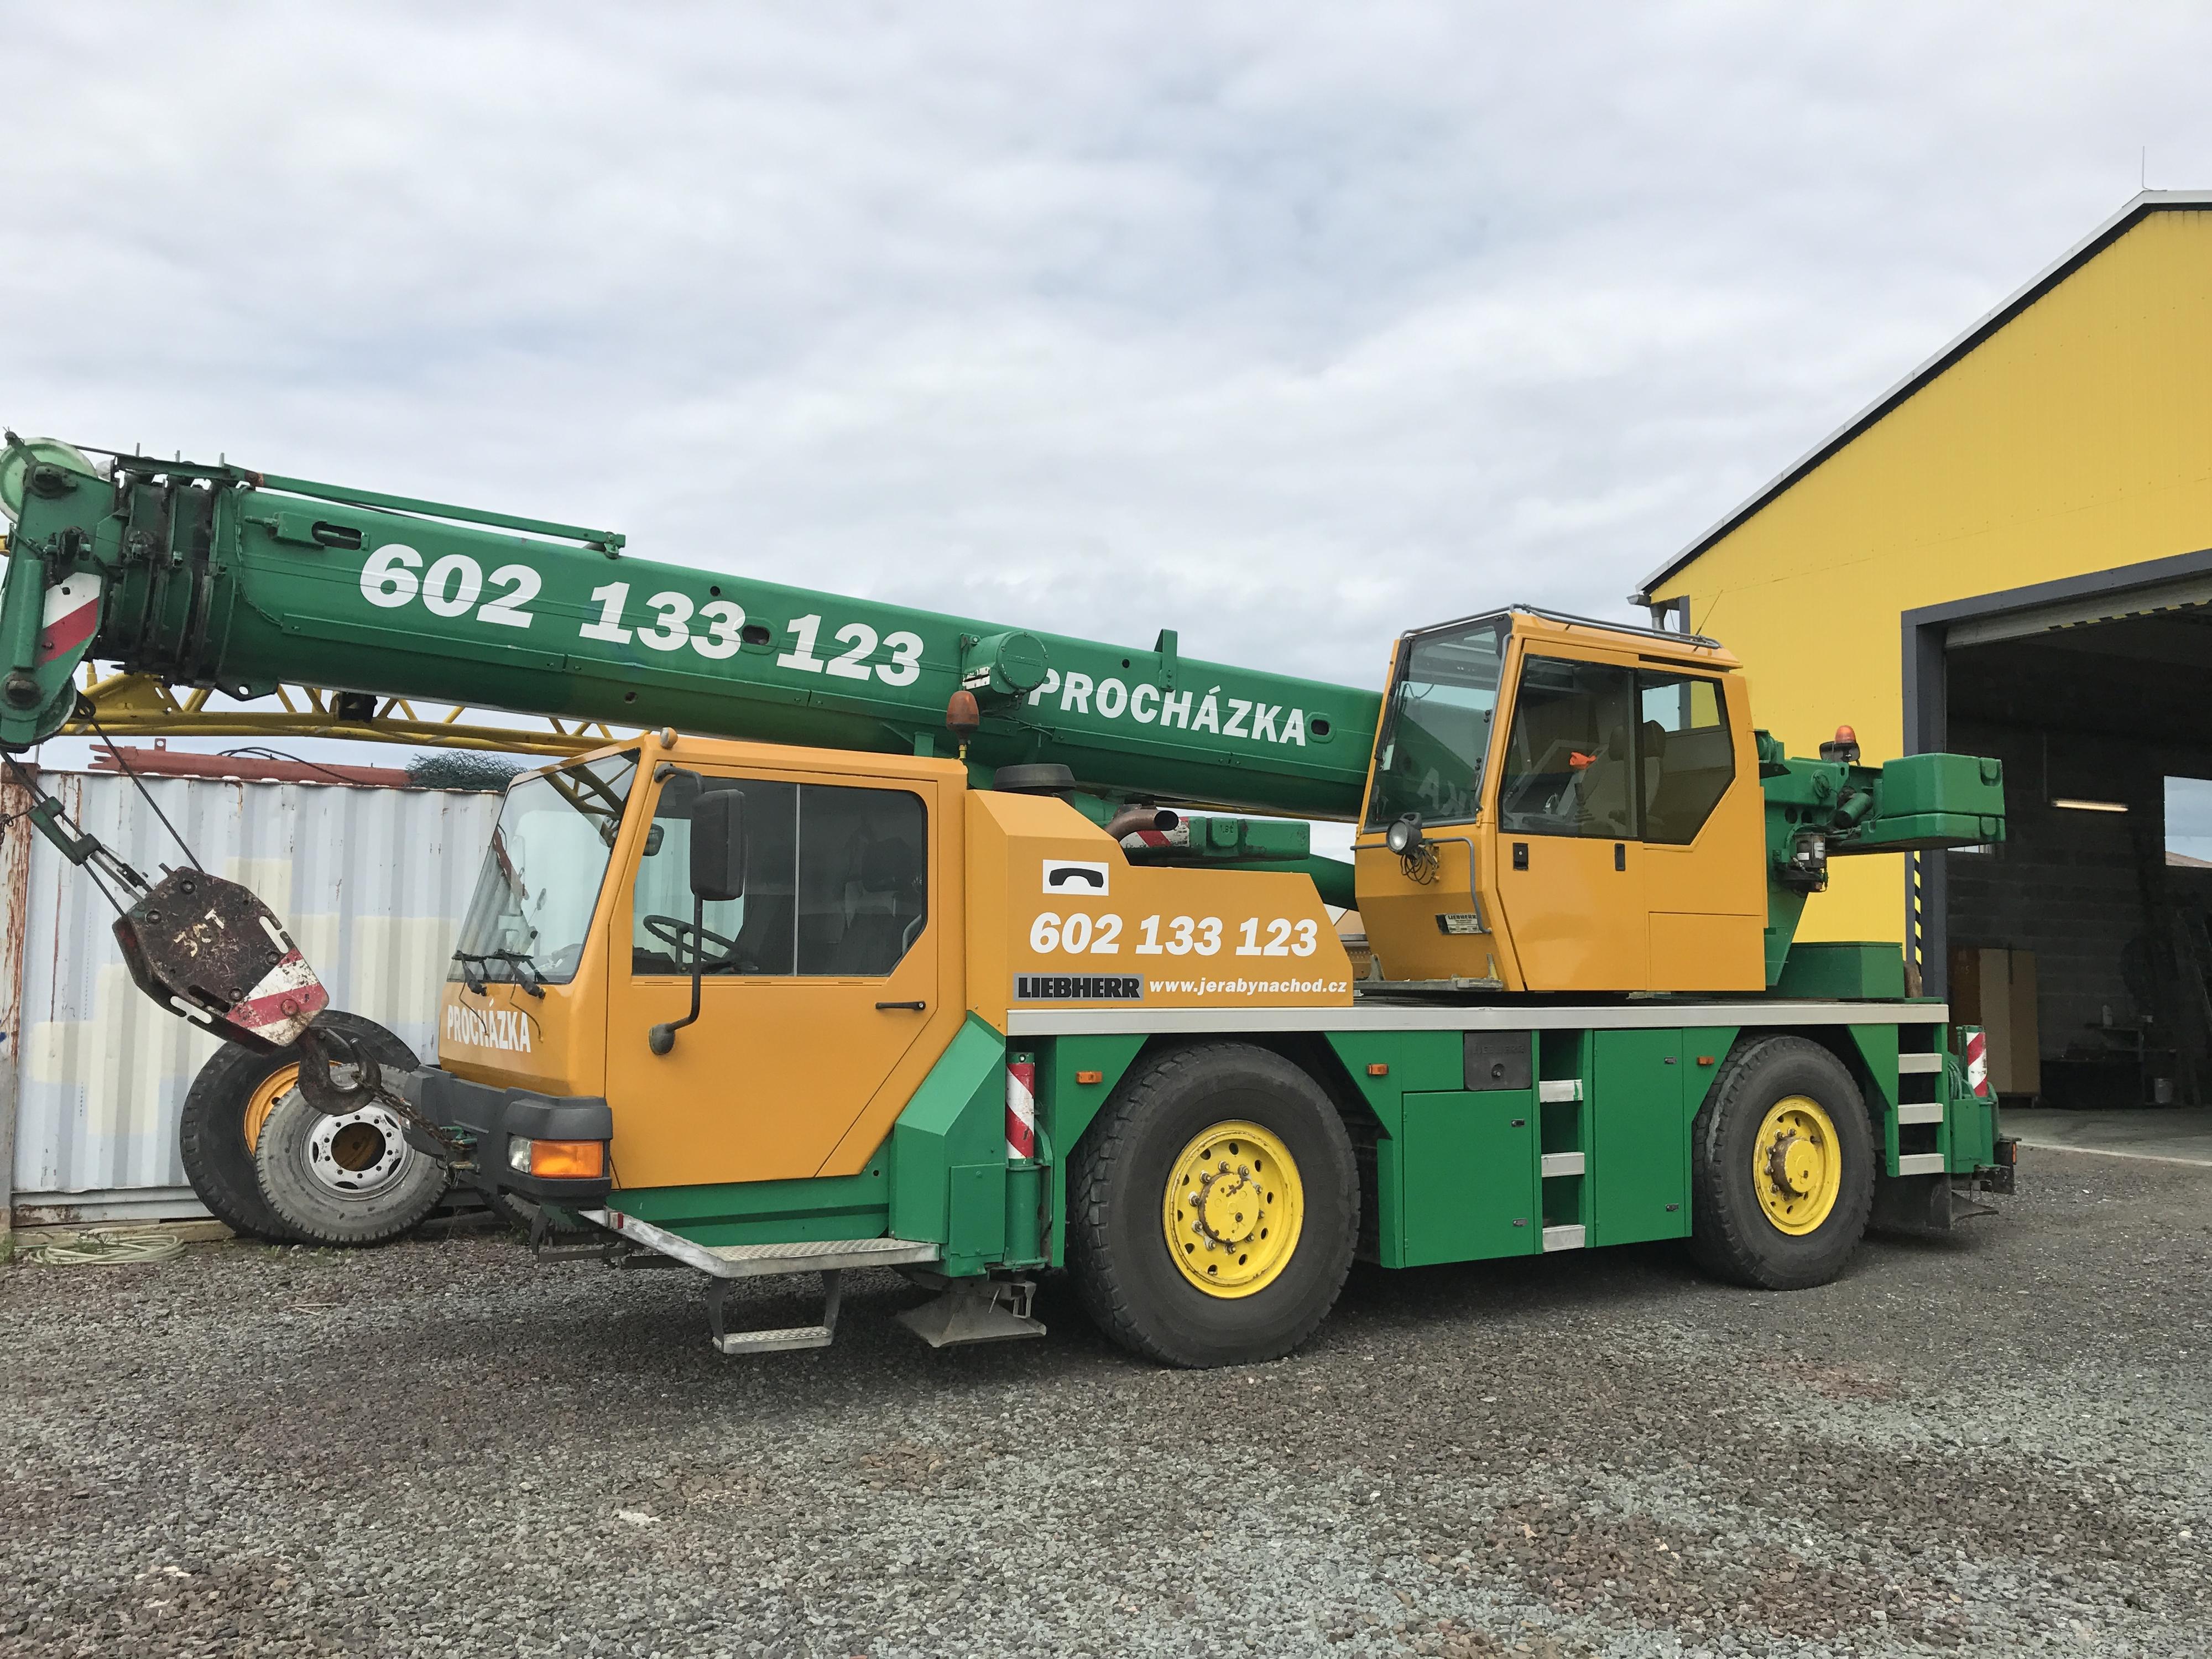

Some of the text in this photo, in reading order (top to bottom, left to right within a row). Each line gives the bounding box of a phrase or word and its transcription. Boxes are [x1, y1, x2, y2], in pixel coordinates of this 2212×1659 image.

[360, 544, 924, 686] 602 133 123
[1028, 668, 1306, 747] PROCHÁZKA
[1030, 912, 1318, 957] 602 133 123
[1018, 977, 1140, 999] LIEBHERR
[1150, 978, 1347, 995] www.jerabynachod.cz
[447, 998, 531, 1053] PROCHÁZKA
